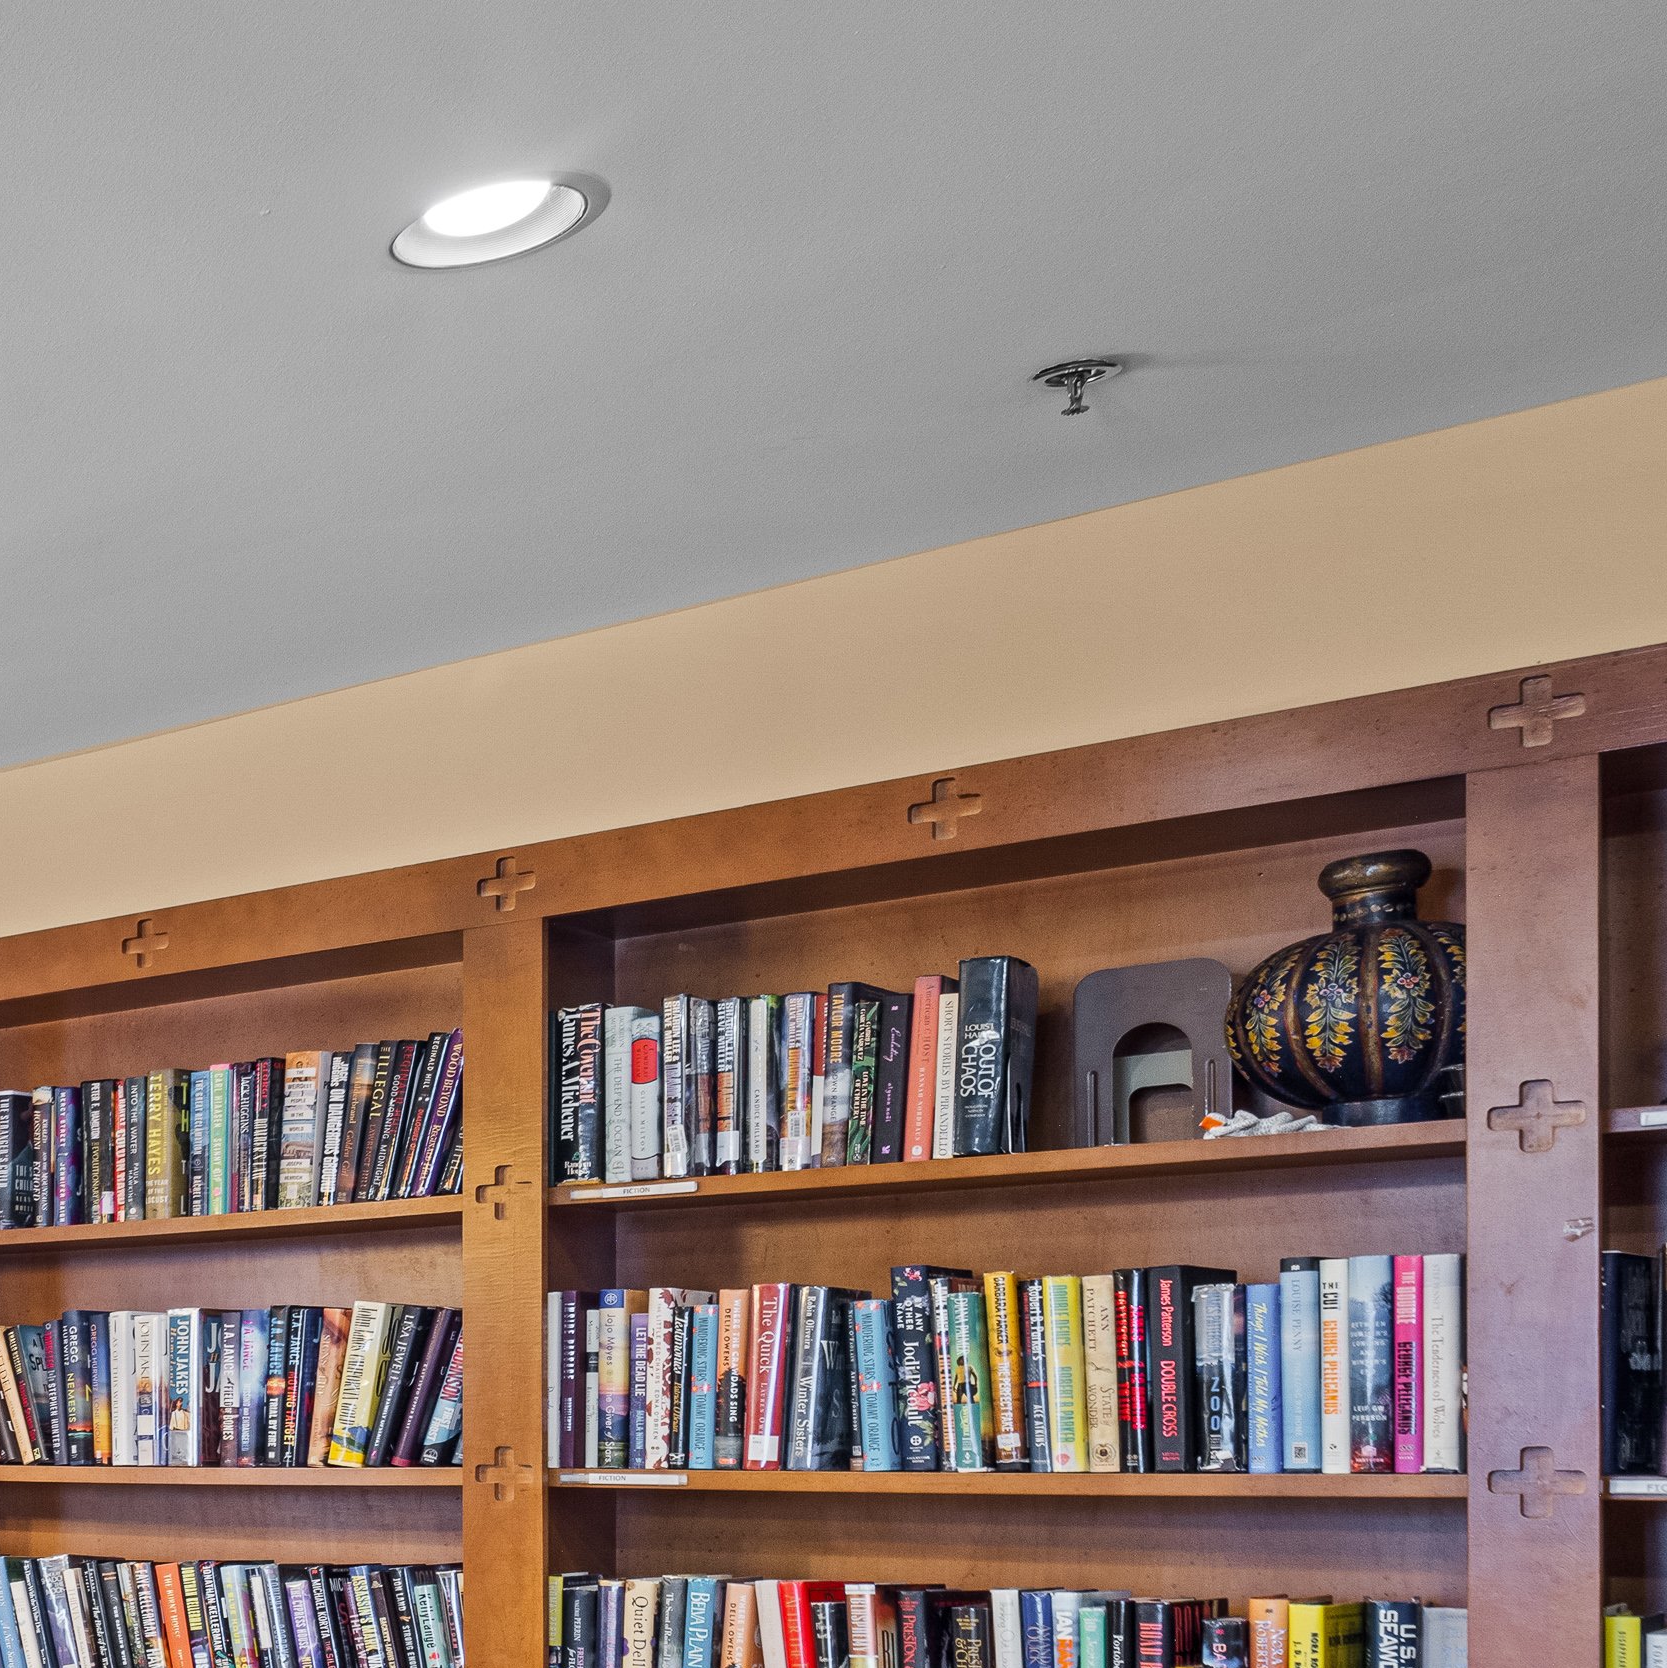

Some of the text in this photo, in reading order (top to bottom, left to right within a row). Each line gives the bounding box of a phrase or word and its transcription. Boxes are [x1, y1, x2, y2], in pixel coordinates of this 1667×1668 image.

[579, 1008, 601, 1032] The
[829, 992, 845, 1060] TAYLOR MOORE
[369, 1054, 390, 1120] ILLEGAL
[561, 1010, 579, 1142] James A. Michener
[938, 1000, 954, 1156] SHORT STORIES BY PIRANDELLO
[959, 1044, 977, 1098] CHAOS
[977, 1043, 996, 1098] OUT OF
[129, 1126, 137, 1154] WATER
[147, 1073, 163, 1176] TERRY HAYES
[321, 1088, 345, 1192] ON DANGEROUS GROUND
[895, 1302, 905, 1330] NAME
[905, 1300, 914, 1330] OTHER
[914, 1297, 923, 1332] BY ANY
[1323, 1292, 1339, 1310] CUT
[176, 1318, 189, 1394] JOHN JAKES
[389, 1314, 415, 1382] LISA JEWELL
[603, 1313, 616, 1366] Jojo Moyes
[635, 1327, 647, 1396] LET THE DEAD LIE
[673, 1314, 689, 1374] Testimonies
[723, 1308, 731, 1367] DELIA OWENS
[729, 1299, 741, 1422] WHERE THE CRAWDADS SING
[759, 1296, 777, 1374] The Quick
[1160, 1279, 1177, 1437] James Patterson DOUBLE CROSS
[1322, 1320, 1337, 1358] GEORGE
[67, 1372, 77, 1423] NEMESIS
[673, 1382, 683, 1404] Patrick
[694, 1316, 709, 1450] WANDERING STARS TOMMY ORANGE
[795, 1296, 817, 1457] Robin Oliveira Winter Sisters
[903, 1340, 923, 1426] Jodi Picoult
[1431, 1316, 1445, 1439] The Tenderness of Wolves
[605, 1405, 614, 1430] Giver
[598, 1474, 627, 1482] FICTION
[604, 1440, 613, 1462] Stars
[632, 1596, 649, 1668] Quiet Dell
[690, 1592, 711, 1624] BELVA
[687, 1628, 709, 1668] PLAIN
[1139, 1622, 1163, 1656] ROAD
